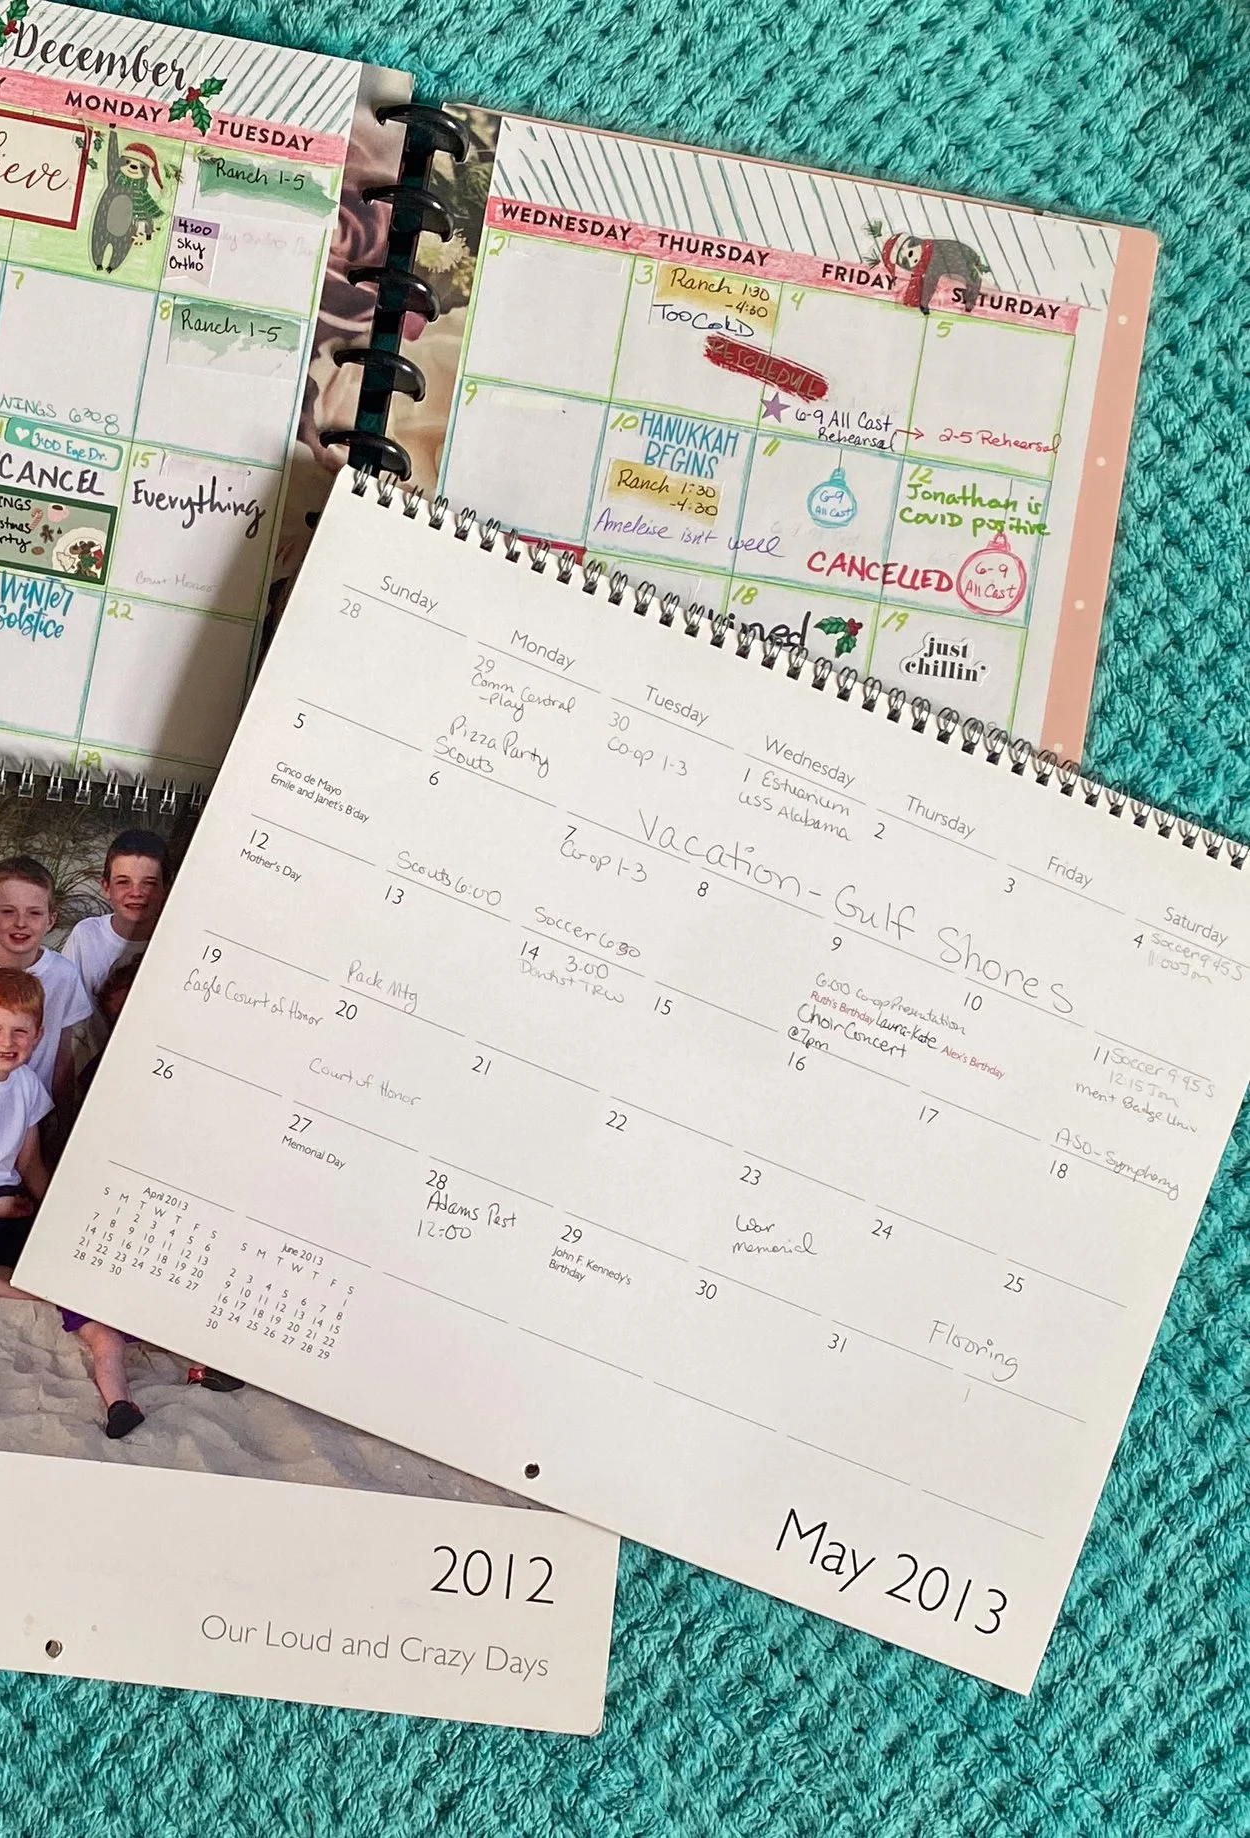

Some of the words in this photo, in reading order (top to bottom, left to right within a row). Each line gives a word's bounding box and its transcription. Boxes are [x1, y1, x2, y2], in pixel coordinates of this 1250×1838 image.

[12, 20, 187, 93] December
[64, 91, 164, 123] MONDAY
[218, 120, 314, 152] TUESDAY
[216, 158, 268, 185] Ranch
[279, 171, 306, 190] 1-5
[178, 219, 212, 235] 4:00
[501, 203, 633, 242] WEDNESDAY
[658, 233, 770, 267] THURSDAY
[822, 263, 897, 291] FRIDAY
[169, 256, 204, 271] Ortho
[671, 268, 732, 295] Ranch
[181, 309, 240, 334] Ranch
[250, 322, 282, 342] 1-5
[710, 335, 821, 399] RESCHEDULE
[639, 411, 740, 457] HANUKKAH
[795, 408, 824, 425] 6-9
[829, 411, 850, 430] All
[858, 411, 893, 432] Cast
[66, 440, 87, 460] Eye
[818, 426, 897, 452] Rehearsal
[939, 429, 972, 444] 2-5
[978, 430, 1061, 454] Rehearsal
[644, 442, 719, 479] BEGINS
[617, 468, 670, 494] Ranch
[681, 481, 716, 498] 1:30
[905, 483, 1017, 512] Jonathan
[1027, 496, 1041, 515] is
[132, 476, 266, 539] Everything
[973, 516, 1051, 537] positive
[807, 551, 954, 592] CANCELLED
[974, 564, 1008, 578] 6-9
[984, 583, 1016, 599] Cast
[339, 598, 362, 618] 28
[925, 637, 968, 658] just
[520, 690, 575, 714] Central
[609, 712, 630, 731] 30
[380, 575, 439, 612] Sunday
[511, 630, 575, 670] Monday
[647, 685, 709, 726] Tuesday
[765, 735, 855, 789] Wednesday
[908, 795, 976, 839] Thursday
[1047, 856, 1093, 888] Friday
[1164, 907, 1229, 948] Saturday
[434, 736, 494, 774] Scouts
[449, 716, 497, 750] Pizza
[503, 731, 550, 778] Party
[276, 761, 302, 778] Cinco
[304, 773, 316, 785] de
[318, 777, 342, 796] Mayo
[271, 774, 295, 792] Emile
[297, 785, 314, 799] and
[315, 790, 344, 814] Janet's
[346, 804, 370, 824] B'day
[250, 830, 270, 850] 12
[777, 807, 851, 841] Alabama
[241, 848, 280, 873] Mother's
[282, 865, 301, 882] Day
[397, 851, 451, 887] Scouts
[535, 906, 596, 941] Soccer
[639, 808, 801, 897] Vacation
[835, 885, 915, 940] Gulf
[938, 927, 1073, 1014] Shores
[347, 960, 382, 989] Pack
[566, 955, 609, 979] 3:00
[336, 1000, 358, 1020] 20
[810, 991, 837, 1009] Ruth's
[839, 1002, 875, 1025] Birthday
[798, 1003, 844, 1030] Choir
[844, 1022, 907, 1057] Concert
[941, 1046, 968, 1063] Alex's
[970, 1057, 1005, 1080] Birthday
[309, 1058, 352, 1082] Court
[380, 1079, 421, 1105] Honor
[288, 1114, 312, 1132] 27
[605, 1111, 628, 1132] 22
[282, 1136, 325, 1161] Memorial
[327, 1153, 346, 1169] Day
[142, 1186, 164, 1201] April
[165, 1194, 189, 1211] 2013
[427, 1191, 480, 1222] Adams
[417, 1220, 472, 1240] 12:00
[735, 1214, 775, 1233] War
[281, 1242, 299, 1255] June
[300, 1250, 324, 1266] 2013
[551, 1246, 573, 1265] John
[586, 1258, 632, 1285] Kennedy's
[548, 1259, 586, 1282] Birthday
[928, 1320, 1019, 1383] Flooring
[430, 1544, 556, 1606] 2012
[776, 1508, 876, 1592] May
[885, 1553, 1009, 1636] 2013
[201, 1615, 257, 1644] Our
[265, 1620, 333, 1653] Loud
[341, 1631, 391, 1660] and
[400, 1637, 473, 1677] Crazy
[485, 1645, 551, 1682] Days
